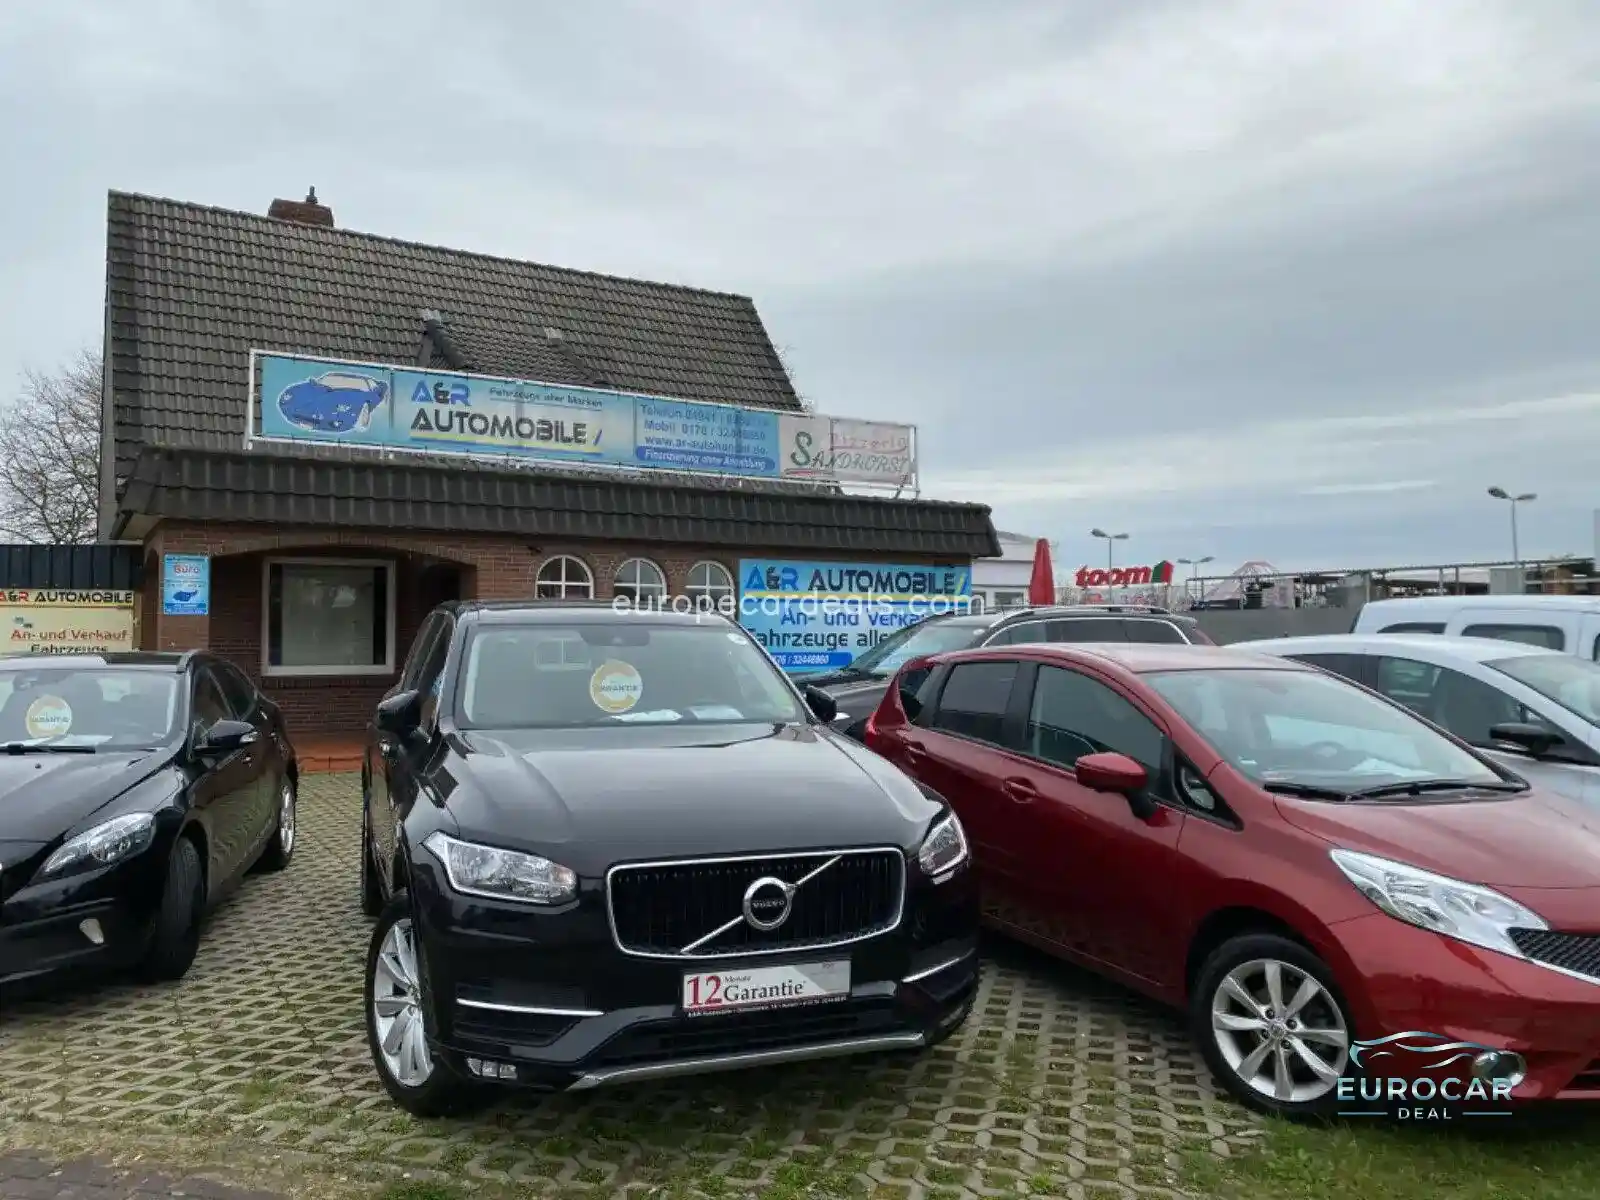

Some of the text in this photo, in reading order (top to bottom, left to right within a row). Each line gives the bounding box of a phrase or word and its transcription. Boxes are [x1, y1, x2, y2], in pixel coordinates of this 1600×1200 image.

[411, 379, 471, 406] A&R
[410, 407, 587, 444] AUTOMOBILE
[744, 565, 956, 594] A&R AUTOMOBILE
[1075, 565, 1152, 587] toom
[35, 591, 133, 604] AUTOMOBILE
[71, 629, 128, 641] Verkauf
[752, 899, 785, 909] VOLVO
[687, 974, 723, 1007] 12
[723, 979, 804, 1003] Garantie
